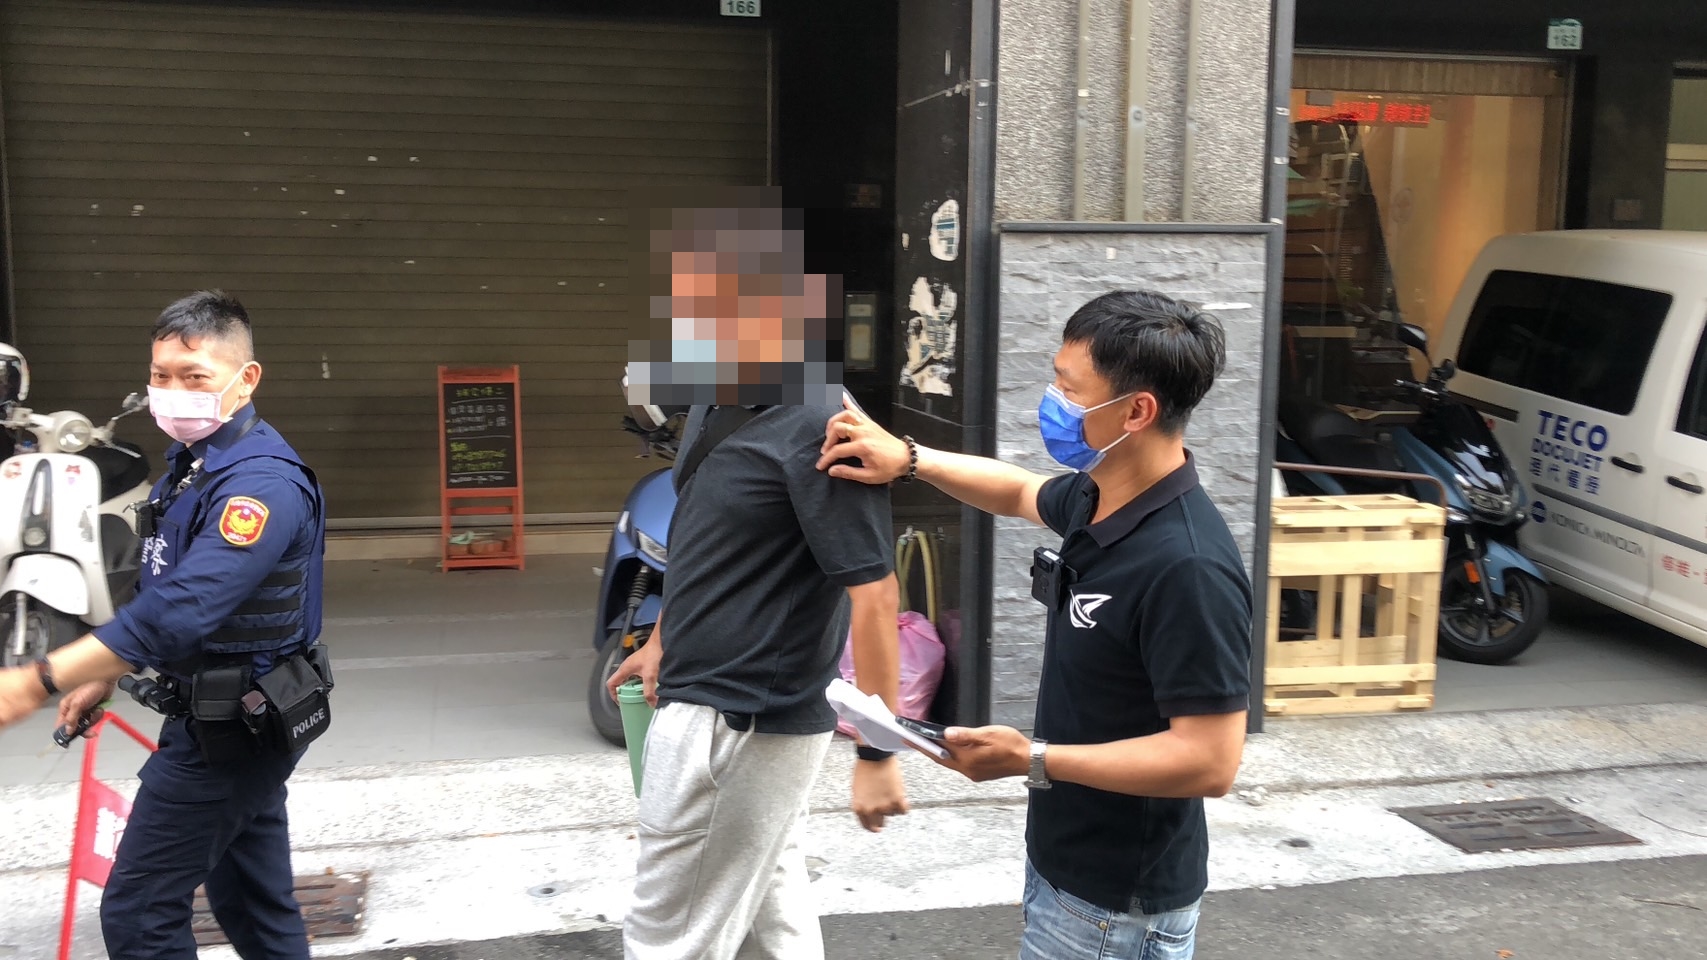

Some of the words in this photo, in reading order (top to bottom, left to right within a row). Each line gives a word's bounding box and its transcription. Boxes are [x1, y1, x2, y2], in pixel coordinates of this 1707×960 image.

[727, 1, 756, 14] 166
[1554, 34, 1576, 47] 162
[1539, 410, 1608, 451] TECO
[1531, 438, 1603, 471] DOCUJET
[292, 707, 325, 739] POLICE
